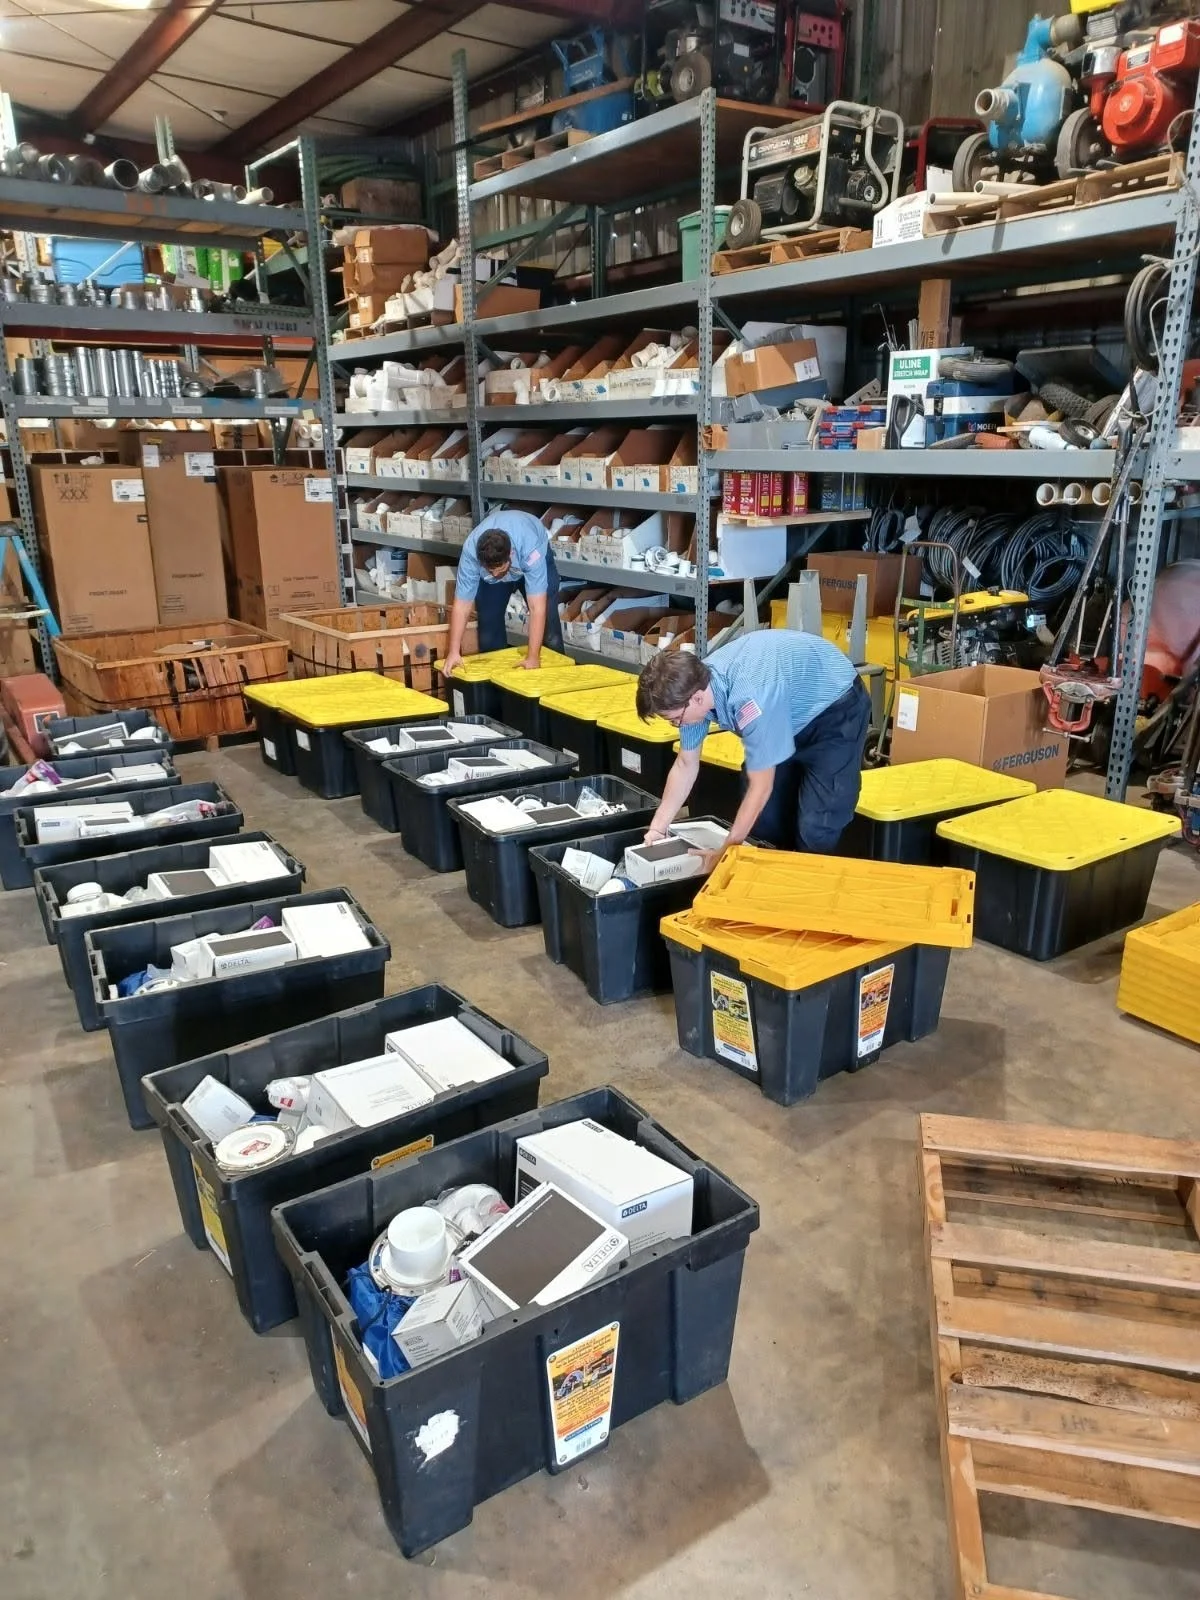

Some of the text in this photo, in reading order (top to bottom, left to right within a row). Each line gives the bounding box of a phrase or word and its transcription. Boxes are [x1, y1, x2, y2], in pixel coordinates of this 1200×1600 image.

[900, 359, 921, 369] ULINE
[1002, 743, 1060, 771] FERGUSON
[227, 958, 251, 969] DELTA
[628, 1202, 647, 1216] DELTA
[583, 1244, 613, 1269] DELTA
